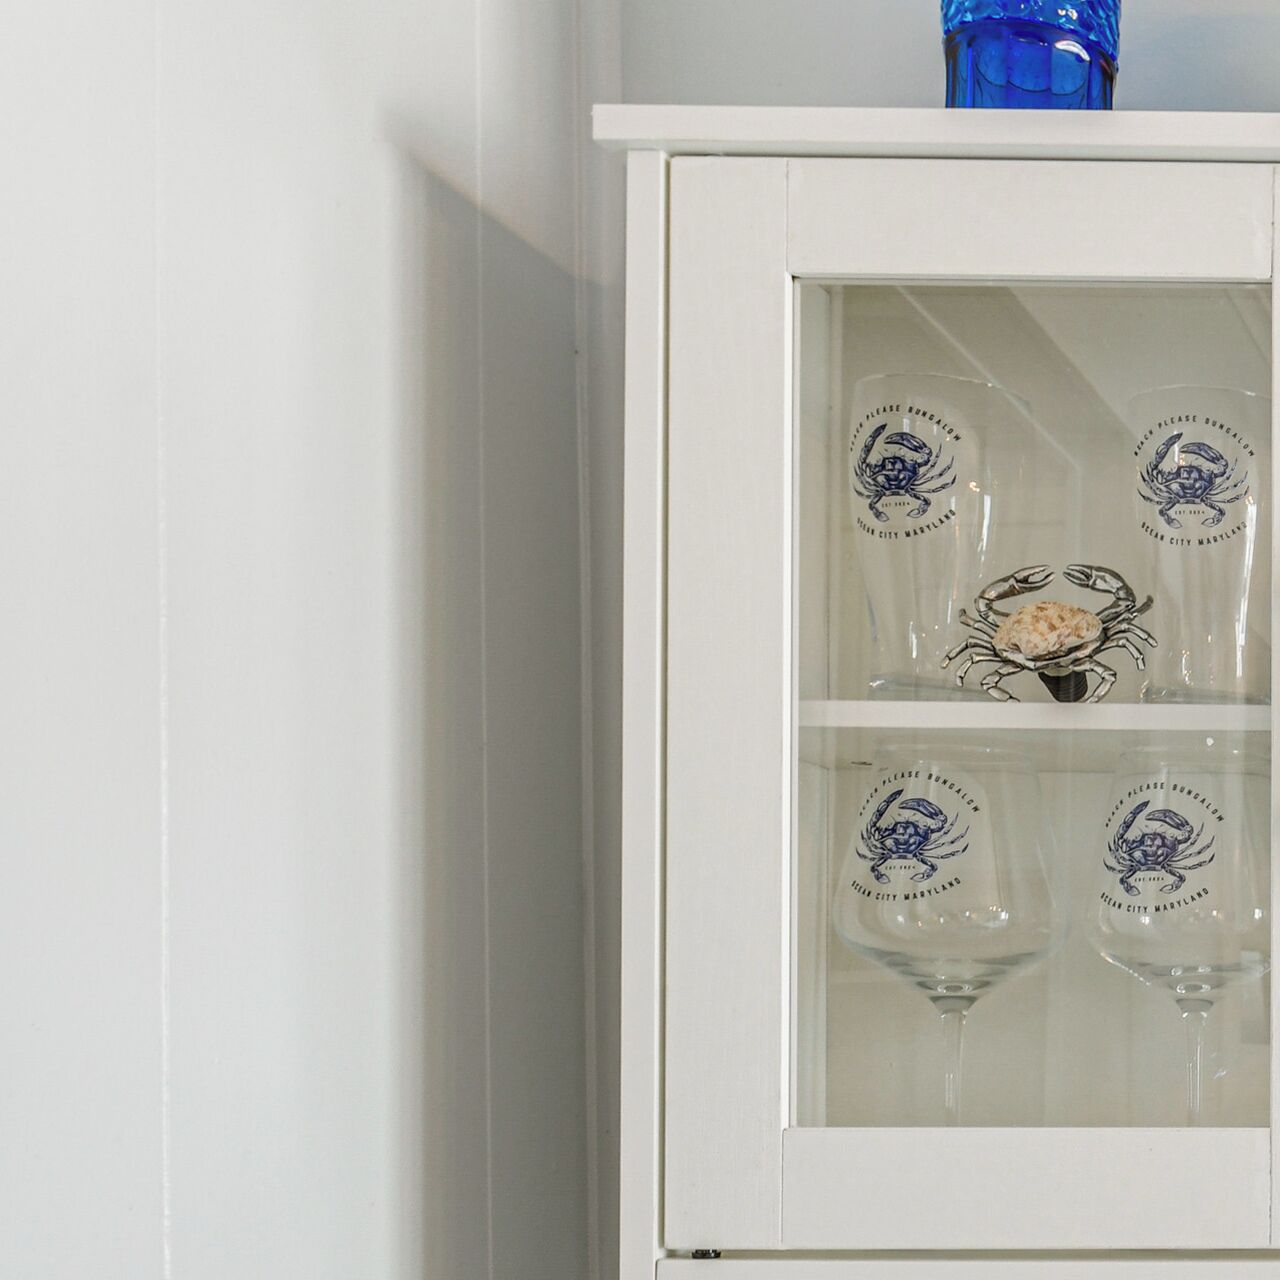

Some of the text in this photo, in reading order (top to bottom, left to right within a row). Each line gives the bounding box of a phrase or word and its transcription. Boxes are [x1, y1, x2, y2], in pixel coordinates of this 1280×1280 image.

[866, 405, 961, 441] PLEASE BUNGALOW
[1158, 415, 1196, 428] PLEASE
[1205, 417, 1254, 457] BUNGALOW
[880, 531, 898, 539] CITY
[905, 509, 956, 537] MARYLAND
[1141, 522, 1164, 541] OCEAN
[883, 771, 980, 812] PLEASE BUNGALOW
[1128, 783, 1224, 822] PLEASE BUNGALOW
[904, 877, 961, 900] MARYLAND
[1127, 905, 1147, 913] CITY
[1155, 888, 1208, 912] MARYLAND
